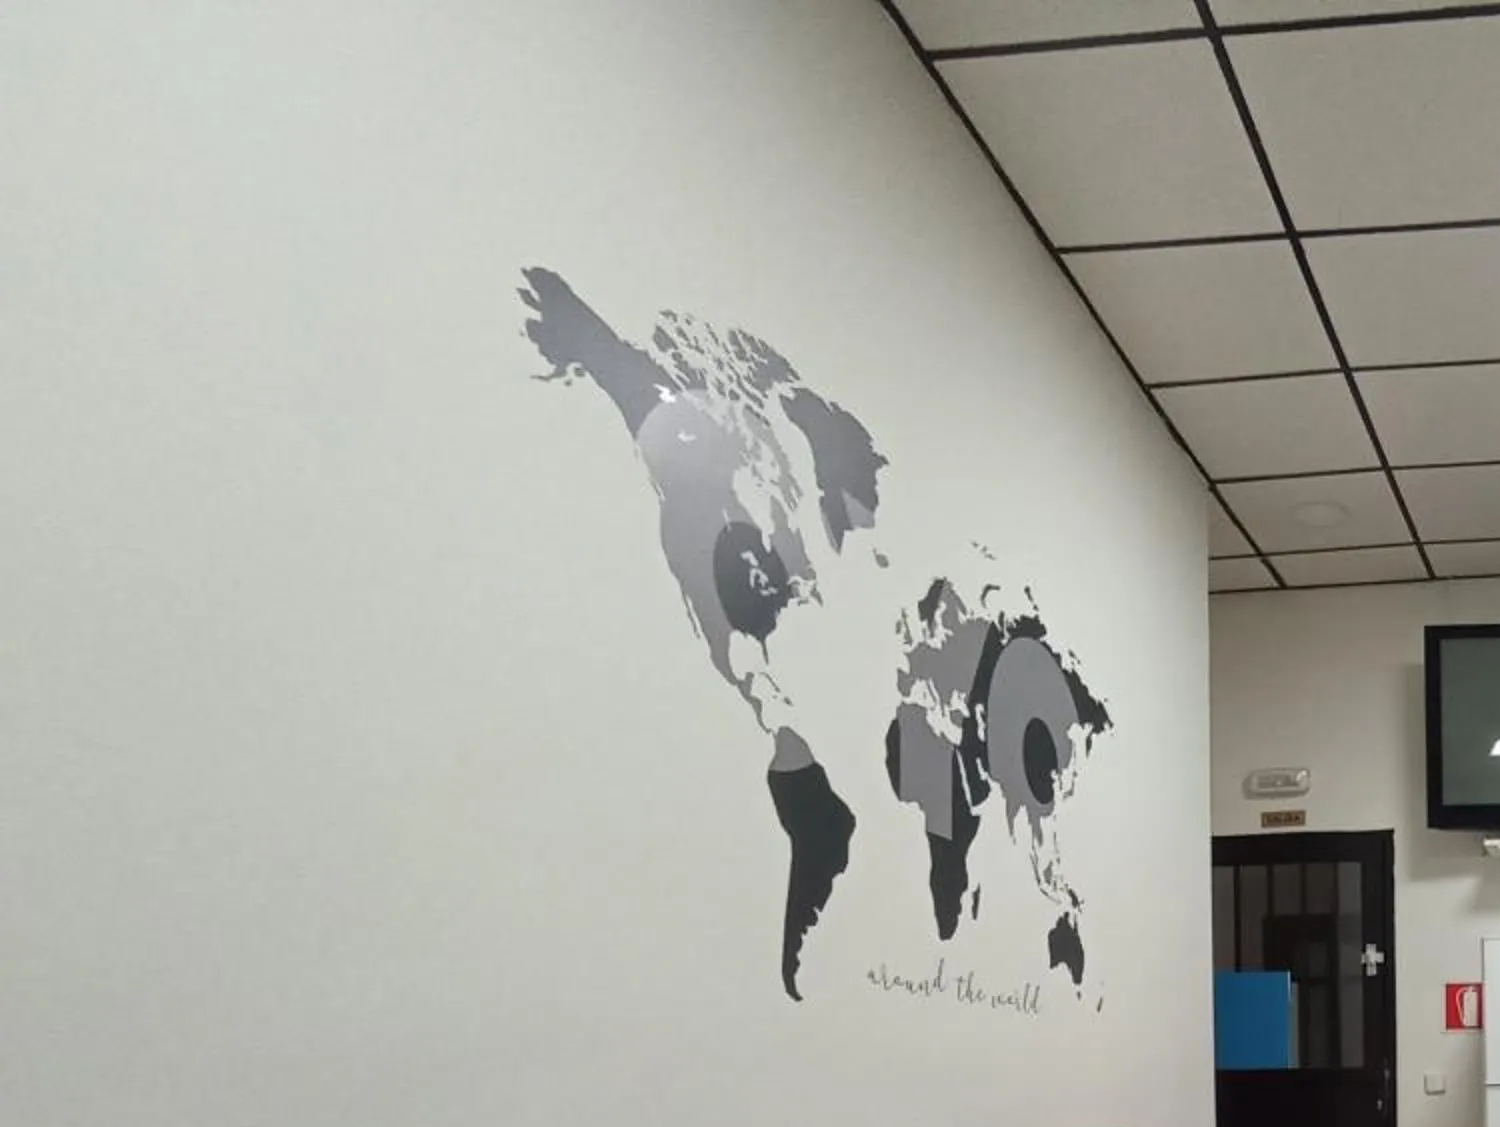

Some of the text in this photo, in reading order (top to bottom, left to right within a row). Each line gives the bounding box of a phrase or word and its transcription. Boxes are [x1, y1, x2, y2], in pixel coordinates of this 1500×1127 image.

[867, 957, 1041, 1014] around the world
